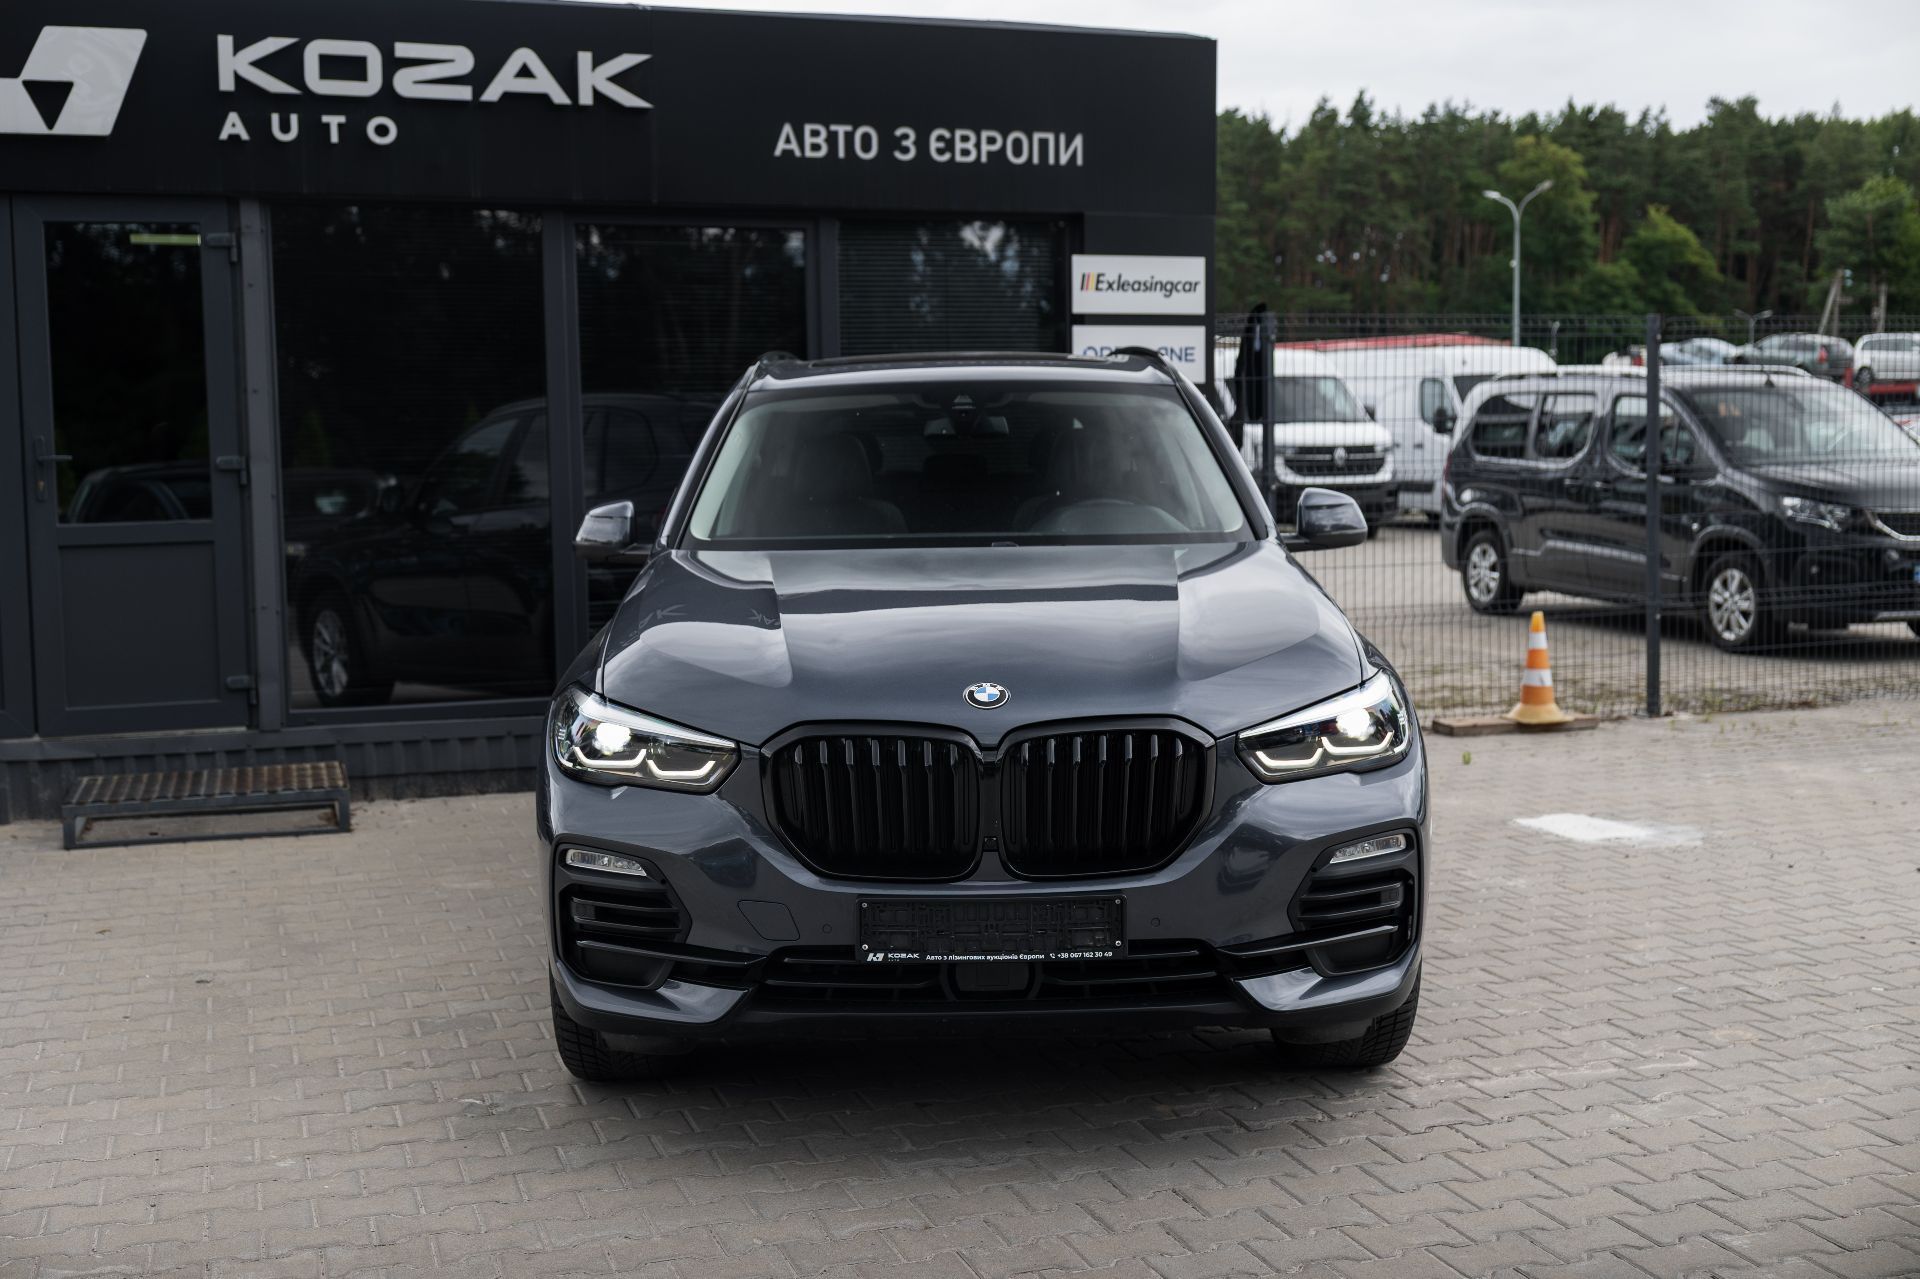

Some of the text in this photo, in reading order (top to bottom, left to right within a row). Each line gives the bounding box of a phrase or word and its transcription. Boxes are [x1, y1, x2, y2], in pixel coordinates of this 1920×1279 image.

[216, 35, 652, 108] KOZAK
[219, 112, 398, 145] AUTO
[773, 122, 879, 161] АВТО
[929, 127, 1084, 167] ЄВРОПИ
[1094, 272, 1200, 298] Exleasingcar
[1019, 952, 1046, 961] Європи
